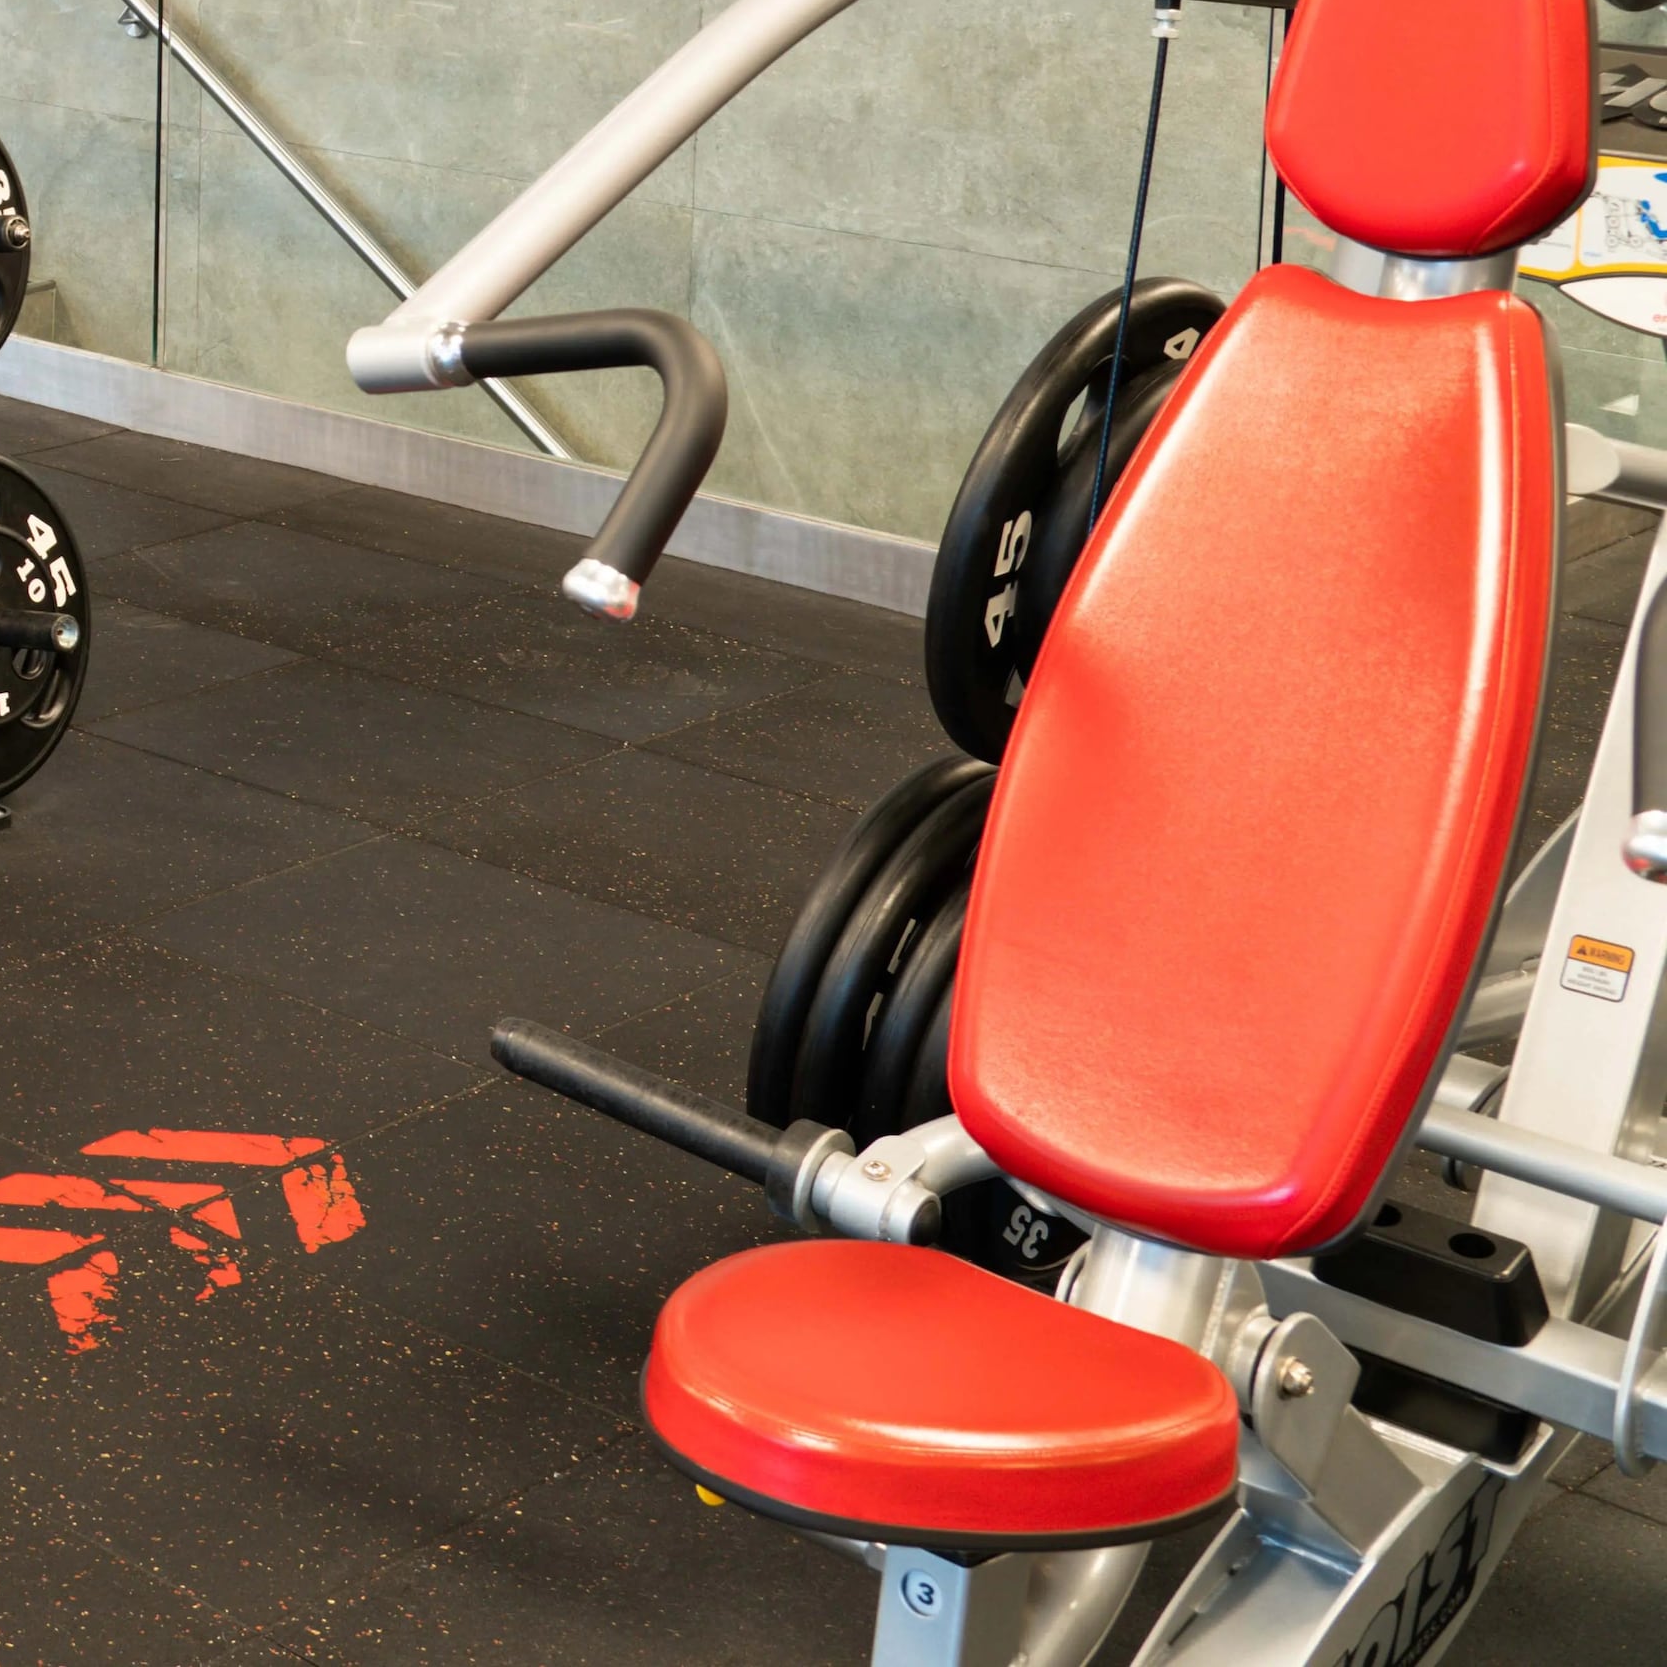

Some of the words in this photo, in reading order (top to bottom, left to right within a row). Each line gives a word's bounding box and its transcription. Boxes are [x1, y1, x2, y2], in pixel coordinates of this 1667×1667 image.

[16, 558, 47, 603] 10
[26, 514, 77, 607] 45
[983, 509, 1033, 648] 45
[1002, 1203, 1049, 1259] 35
[916, 1581, 936, 1606] 3
[1337, 1470, 1507, 1667] OIST
